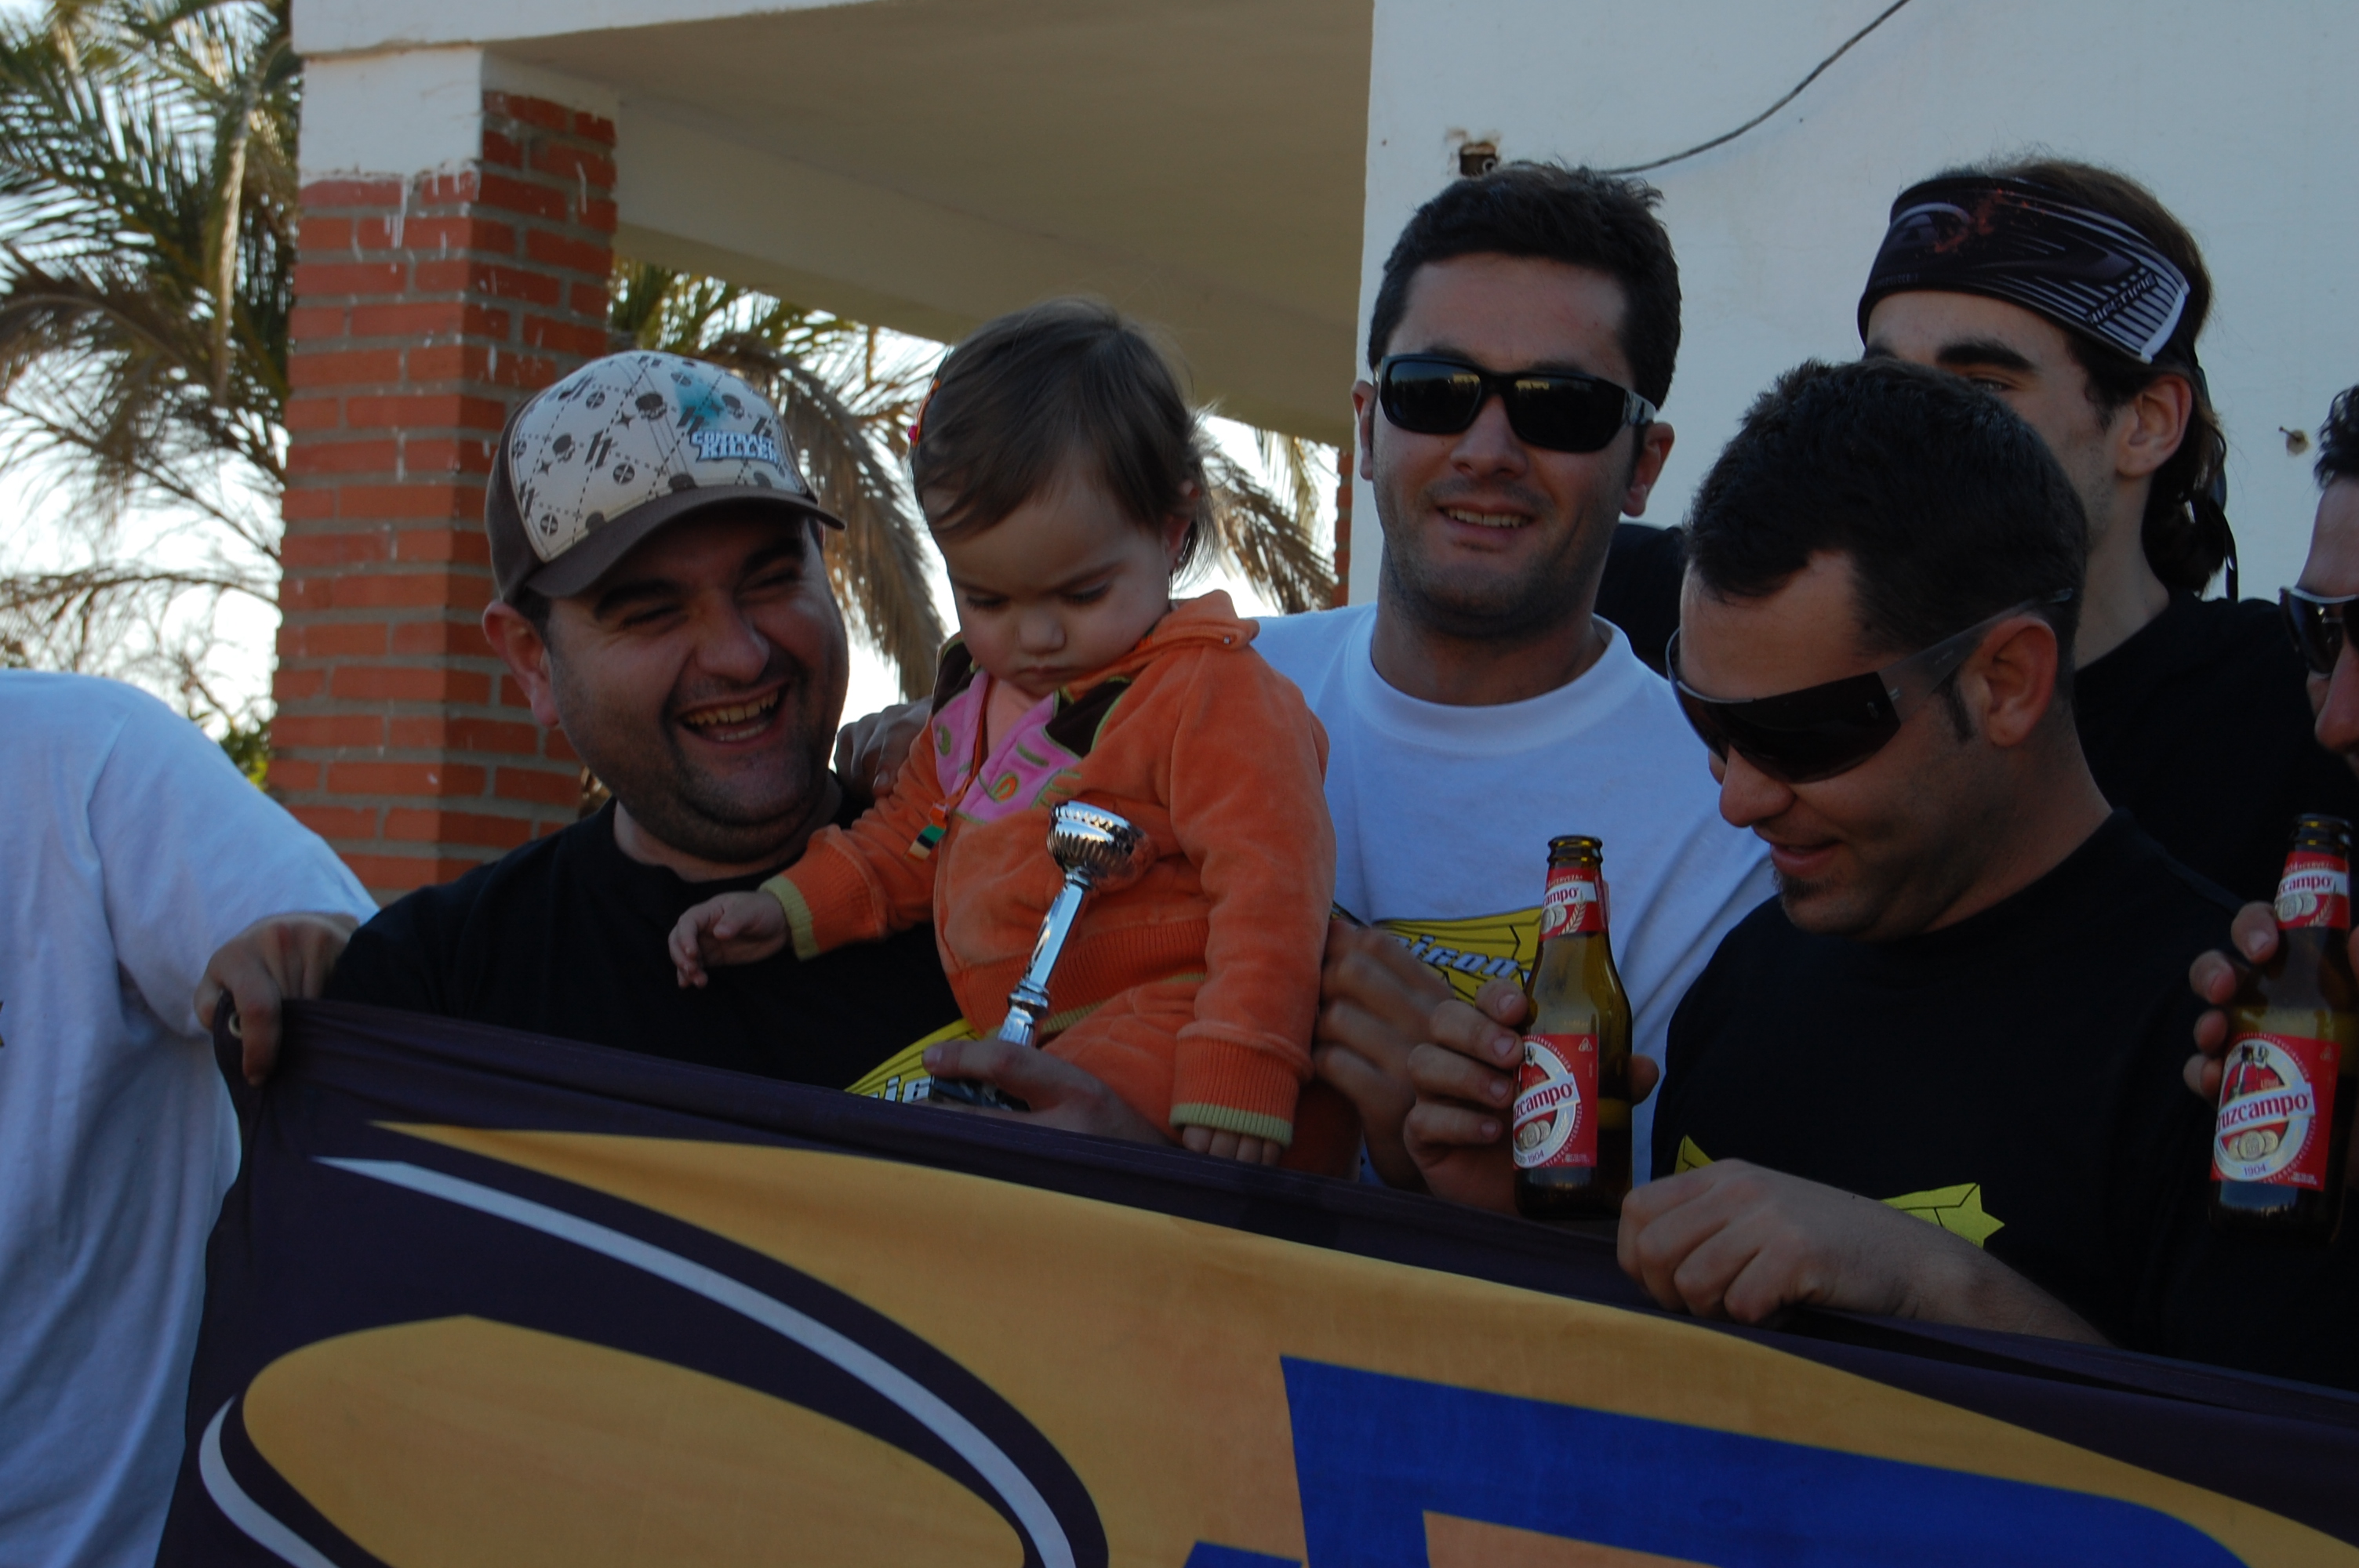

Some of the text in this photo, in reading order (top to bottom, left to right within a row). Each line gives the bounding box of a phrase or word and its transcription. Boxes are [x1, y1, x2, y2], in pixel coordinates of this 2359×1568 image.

[2216, 1093, 2309, 1131] ruzcampo
[1527, 1149, 1544, 1163] 1904
[2244, 1163, 2266, 1176] 1904
